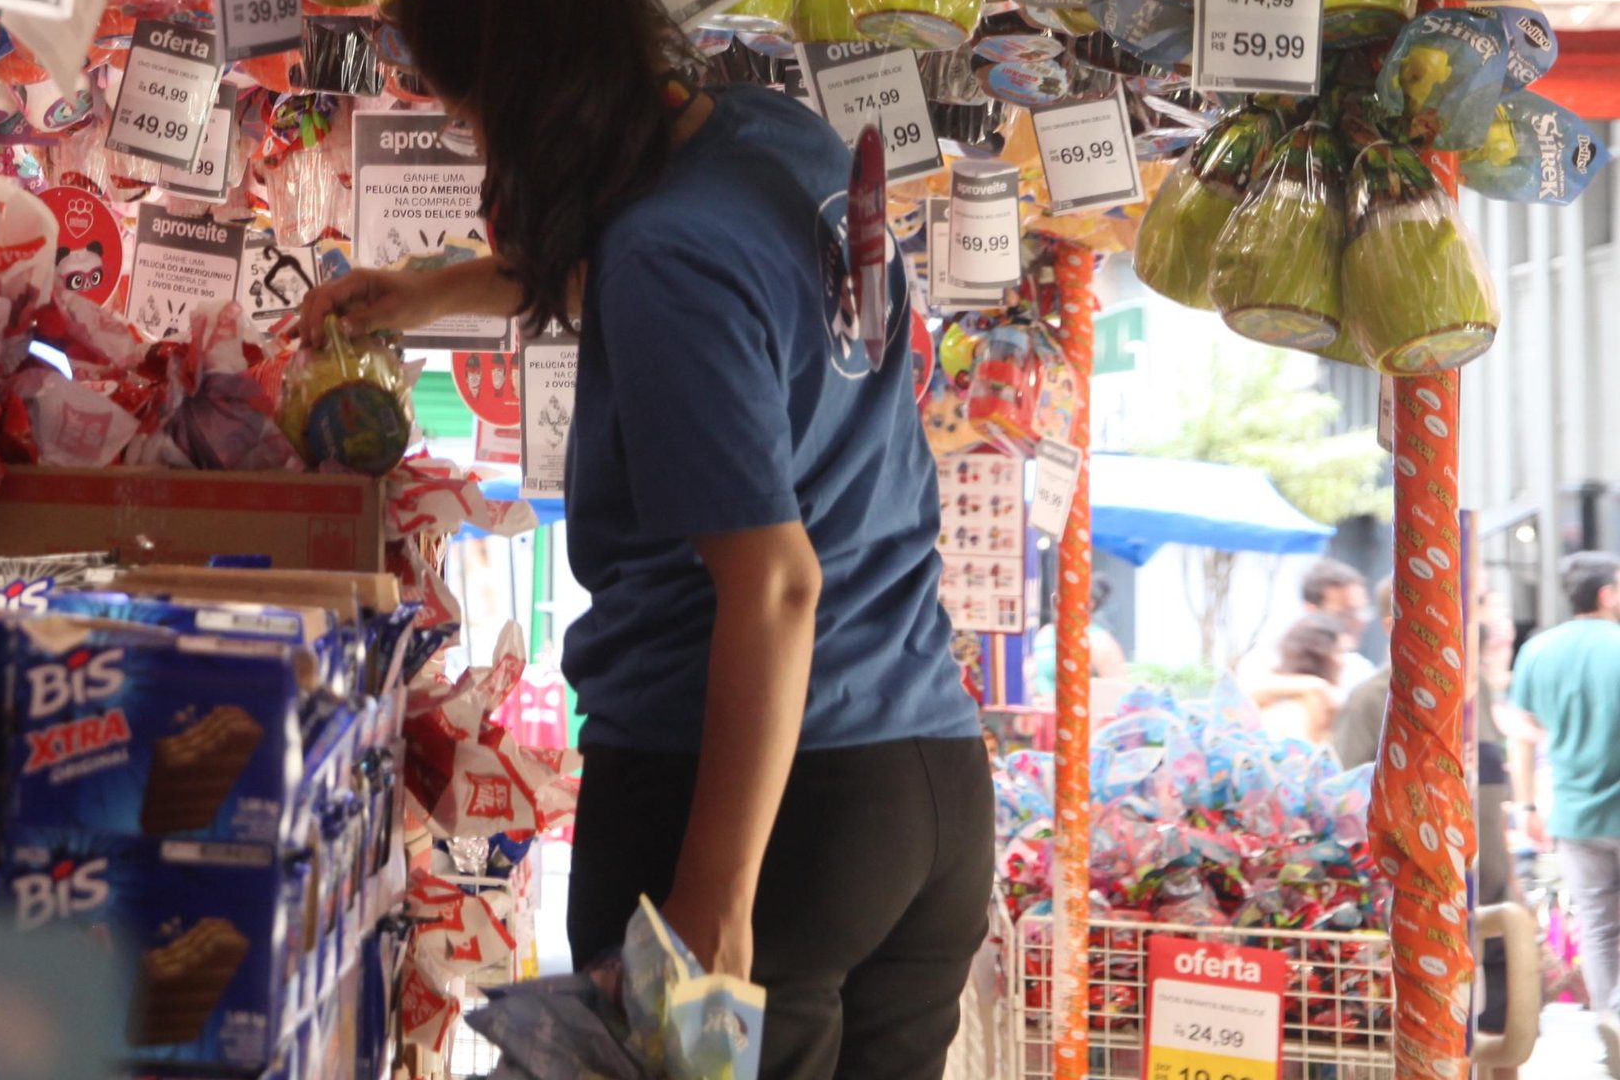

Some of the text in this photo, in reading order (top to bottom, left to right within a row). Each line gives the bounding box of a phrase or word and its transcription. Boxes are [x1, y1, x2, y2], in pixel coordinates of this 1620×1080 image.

[149, 28, 210, 59] oferta
[1211, 31, 1228, 40] por
[1211, 32, 1306, 61] R$ 59,99
[148, 81, 189, 103] 64,99
[855, 88, 900, 112] 74,99
[133, 112, 189, 142] 49,99
[1061, 140, 1115, 165] 69,99
[365, 183, 410, 195] PELÚCIA
[412, 185, 428, 195] DO
[403, 173, 466, 183] GANHE UMA
[394, 197, 473, 207] NA COMPRA DE
[383, 209, 389, 219] 2
[392, 209, 422, 219] OVOS
[424, 209, 462, 219] DELICE
[151, 218, 228, 243] aproveite
[962, 234, 1010, 254] 69,99
[166, 263, 178, 273] DO
[178, 265, 233, 281] AMERIQUINHO
[172, 284, 199, 296] DELICE
[23, 706, 132, 776] XTRA
[1174, 947, 1262, 983] oferta
[1188, 1023, 1245, 1049] 24,99
